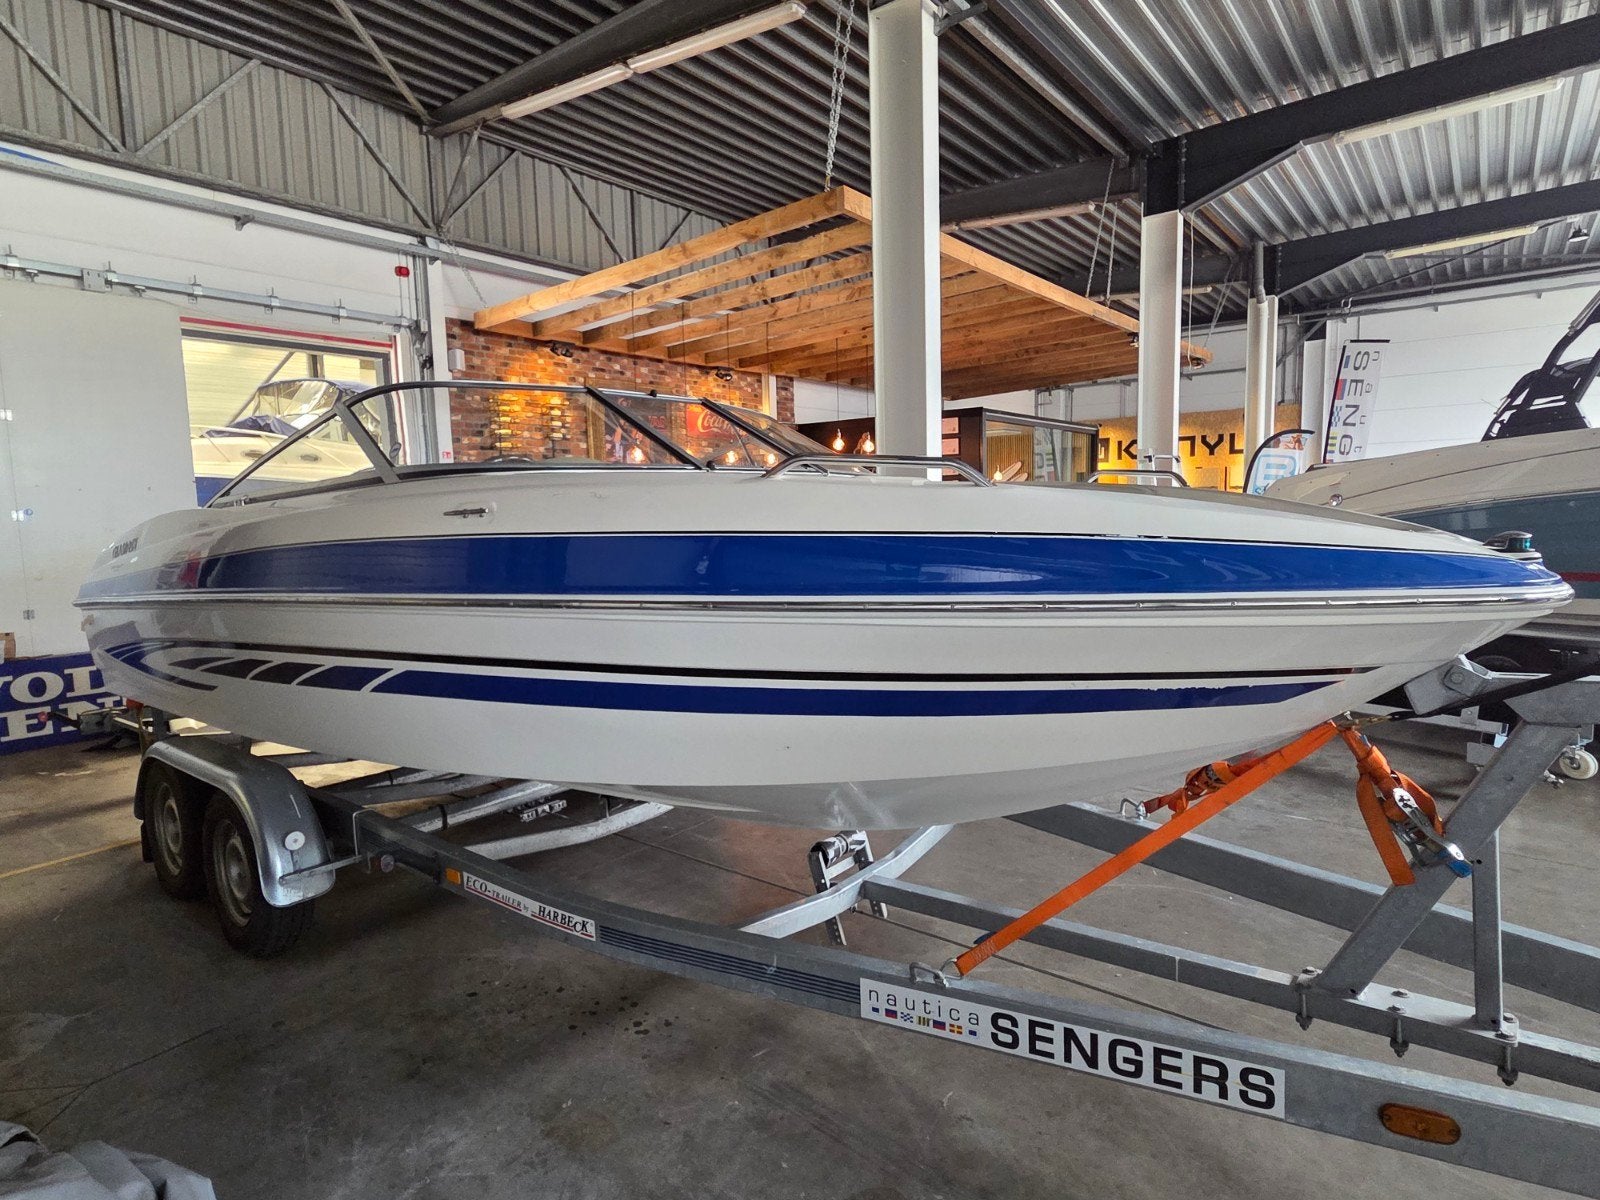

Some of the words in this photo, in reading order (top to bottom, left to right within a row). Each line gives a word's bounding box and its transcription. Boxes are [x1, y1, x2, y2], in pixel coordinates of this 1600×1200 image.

[538, 904, 589, 933] HARBECK
[868, 988, 979, 1027] nautica
[990, 1011, 1276, 1111] SENGERS
